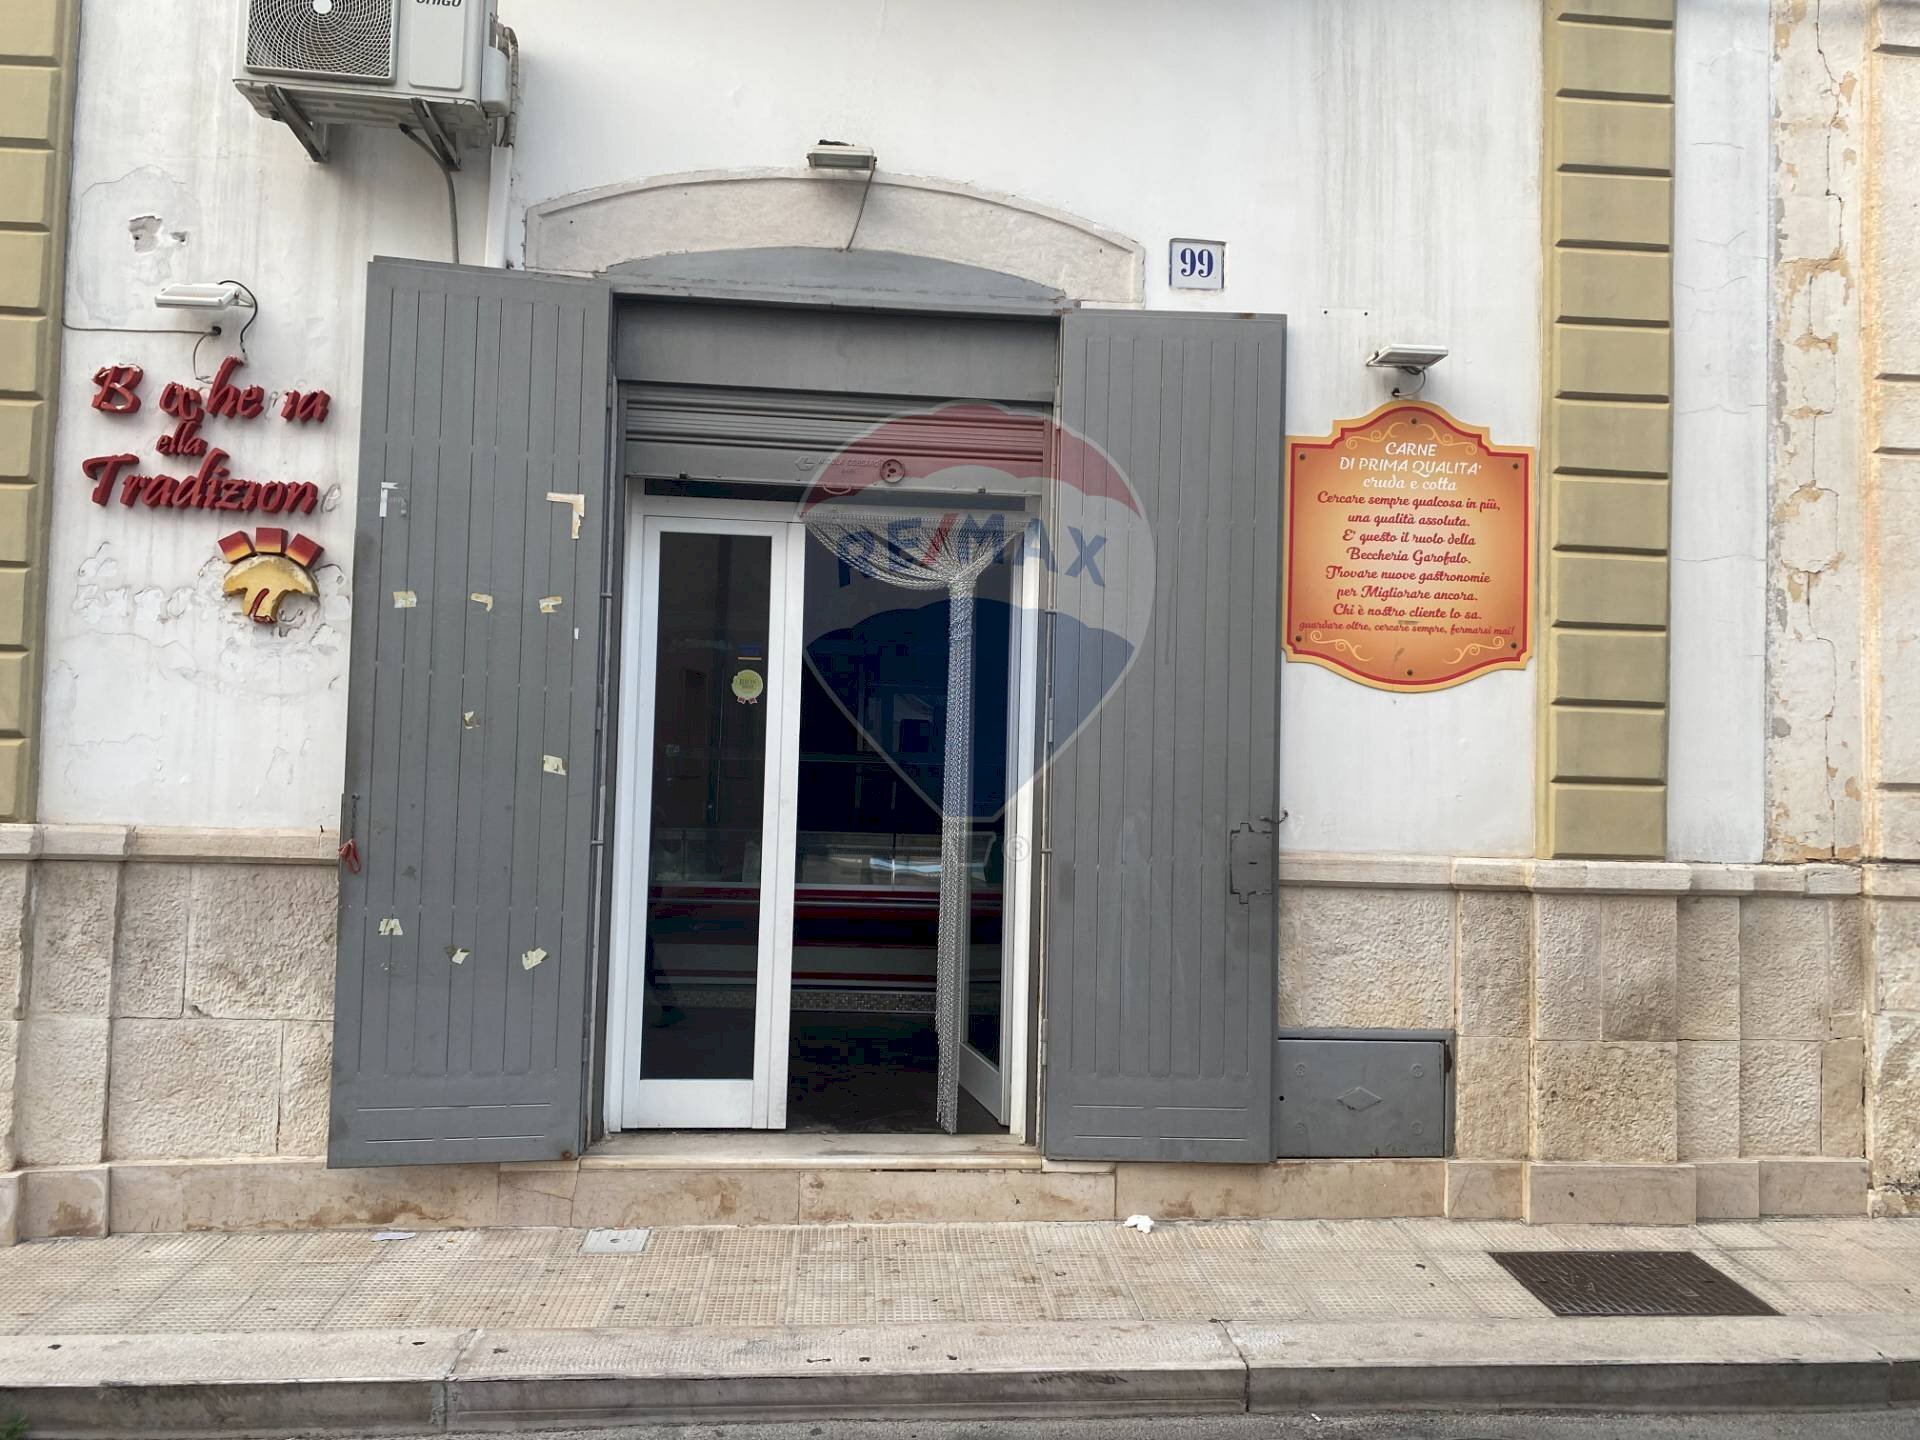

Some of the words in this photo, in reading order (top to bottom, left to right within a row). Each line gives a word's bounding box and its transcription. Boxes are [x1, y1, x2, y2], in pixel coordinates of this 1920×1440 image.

[1180, 247, 1214, 278] 99
[1385, 442, 1437, 456] CARNE
[1340, 457, 1355, 469] DI
[1359, 458, 1409, 472] PRIMA
[1363, 475, 1405, 489] cruda
[1410, 480, 1417, 488] e
[1422, 480, 1457, 491] cotta
[1317, 491, 1365, 504] Cercare
[1368, 496, 1409, 509] sempre
[1412, 497, 1462, 510] qualcosa
[1466, 498, 1476, 508] in
[1479, 499, 1501, 512] più,
[1348, 514, 1370, 522] una
[1374, 513, 1415, 527] qualità
[1419, 516, 1470, 526] assoluta.
[1360, 532, 1397, 545] questo
[1400, 532, 1409, 543] il
[1412, 533, 1445, 544] ruolo
[1447, 533, 1476, 545] della
[1346, 547, 1409, 561] Beccheria
[1413, 550, 1471, 565] Garofalo.
[1325, 565, 1378, 580] Trovare
[1381, 571, 1416, 580] nuove
[1419, 570, 1491, 584] gastronomie
[1336, 587, 1358, 599] per
[1361, 585, 1431, 601] Migliorare
[1434, 592, 1478, 601] ancora.
[1333, 603, 1354, 616] Chi
[1358, 606, 1364, 615] è
[1367, 606, 1405, 617] nostro
[1409, 608, 1447, 619] cliente
[1450, 608, 1461, 618] lo
[1299, 621, 1344, 631] guardare
[1346, 621, 1371, 631] oltre,
[1374, 624, 1409, 632] cercare
[1411, 625, 1447, 635] sempre,
[1450, 624, 1491, 635] fermarsi
[1493, 626, 1515, 636] mai!
